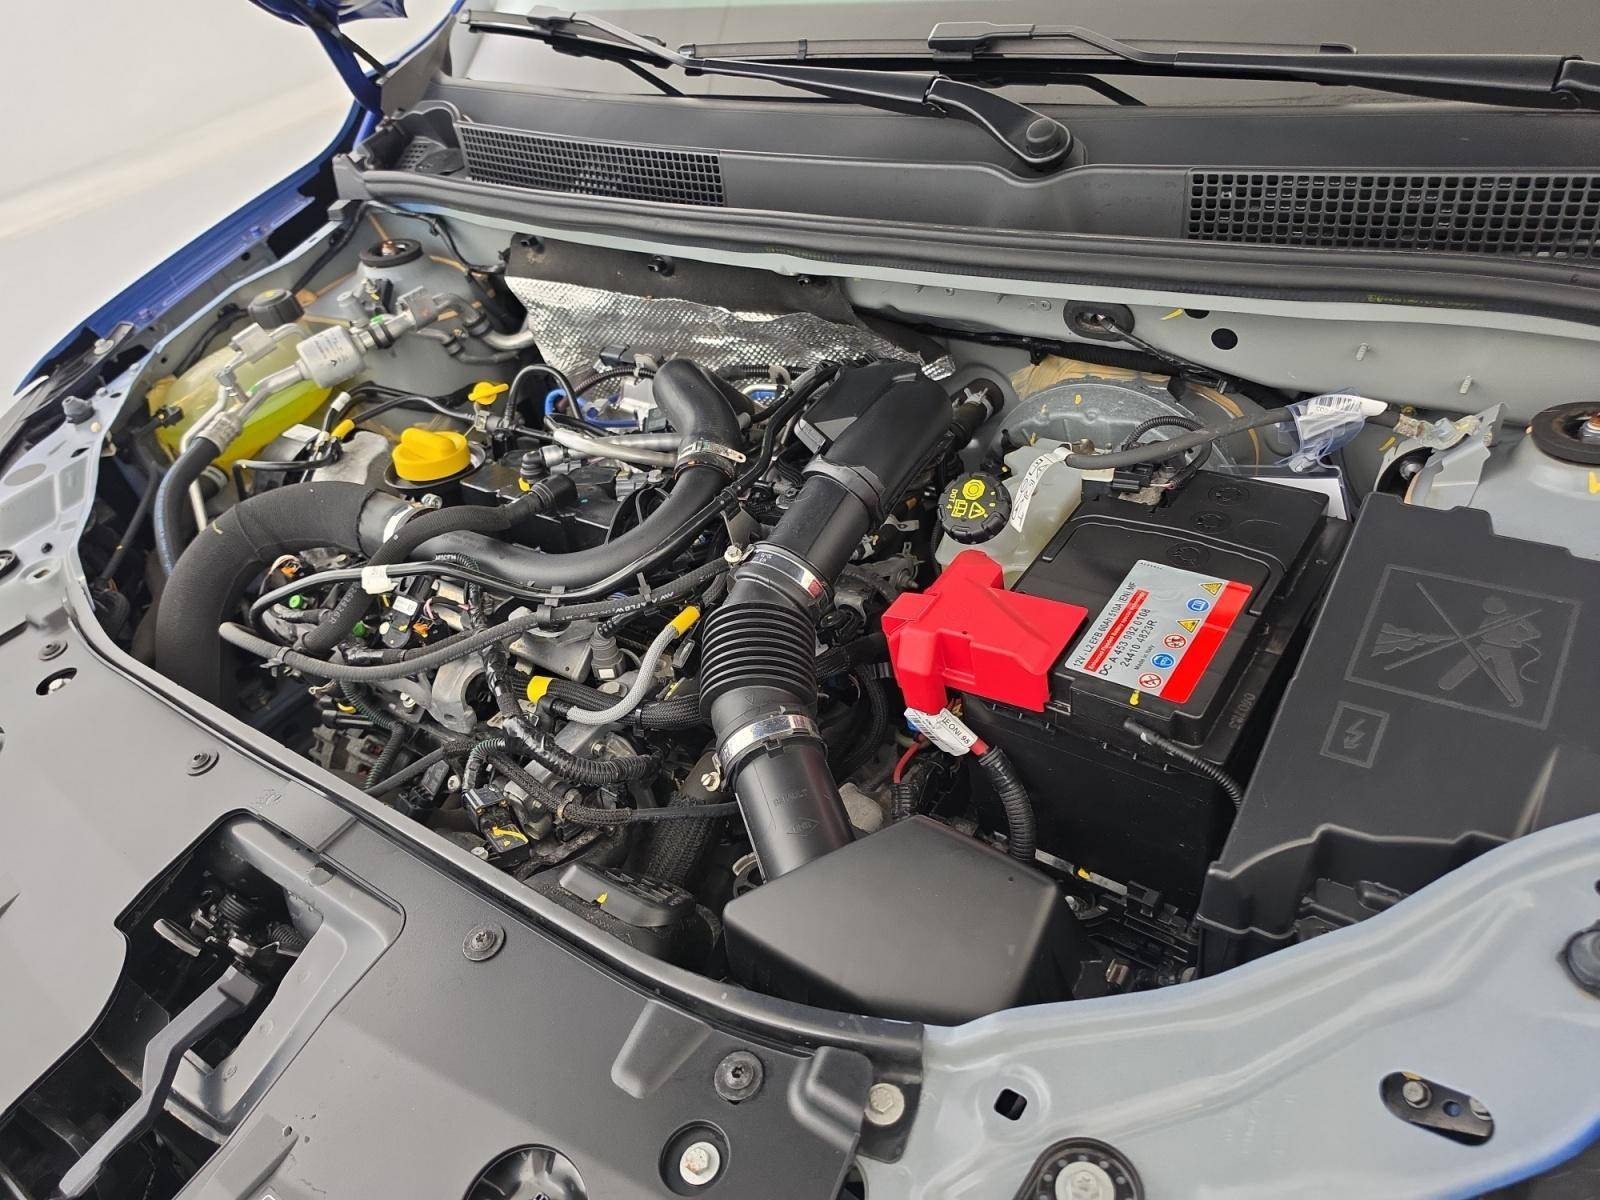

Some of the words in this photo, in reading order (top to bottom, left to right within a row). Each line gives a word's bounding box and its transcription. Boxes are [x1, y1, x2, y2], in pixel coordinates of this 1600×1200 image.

[949, 488, 958, 503] DOT
[1073, 656, 1085, 666] 12V
[1084, 643, 1094, 652] L2
[1090, 632, 1103, 644] EFB
[1126, 582, 1136, 590] MF
[1099, 664, 1112, 675] DC
[1114, 641, 1128, 655] 453
[1123, 626, 1138, 640] 982
[1134, 609, 1150, 625] 0108
[1120, 645, 1141, 667] 24410
[1137, 620, 1157, 643] 4823R
